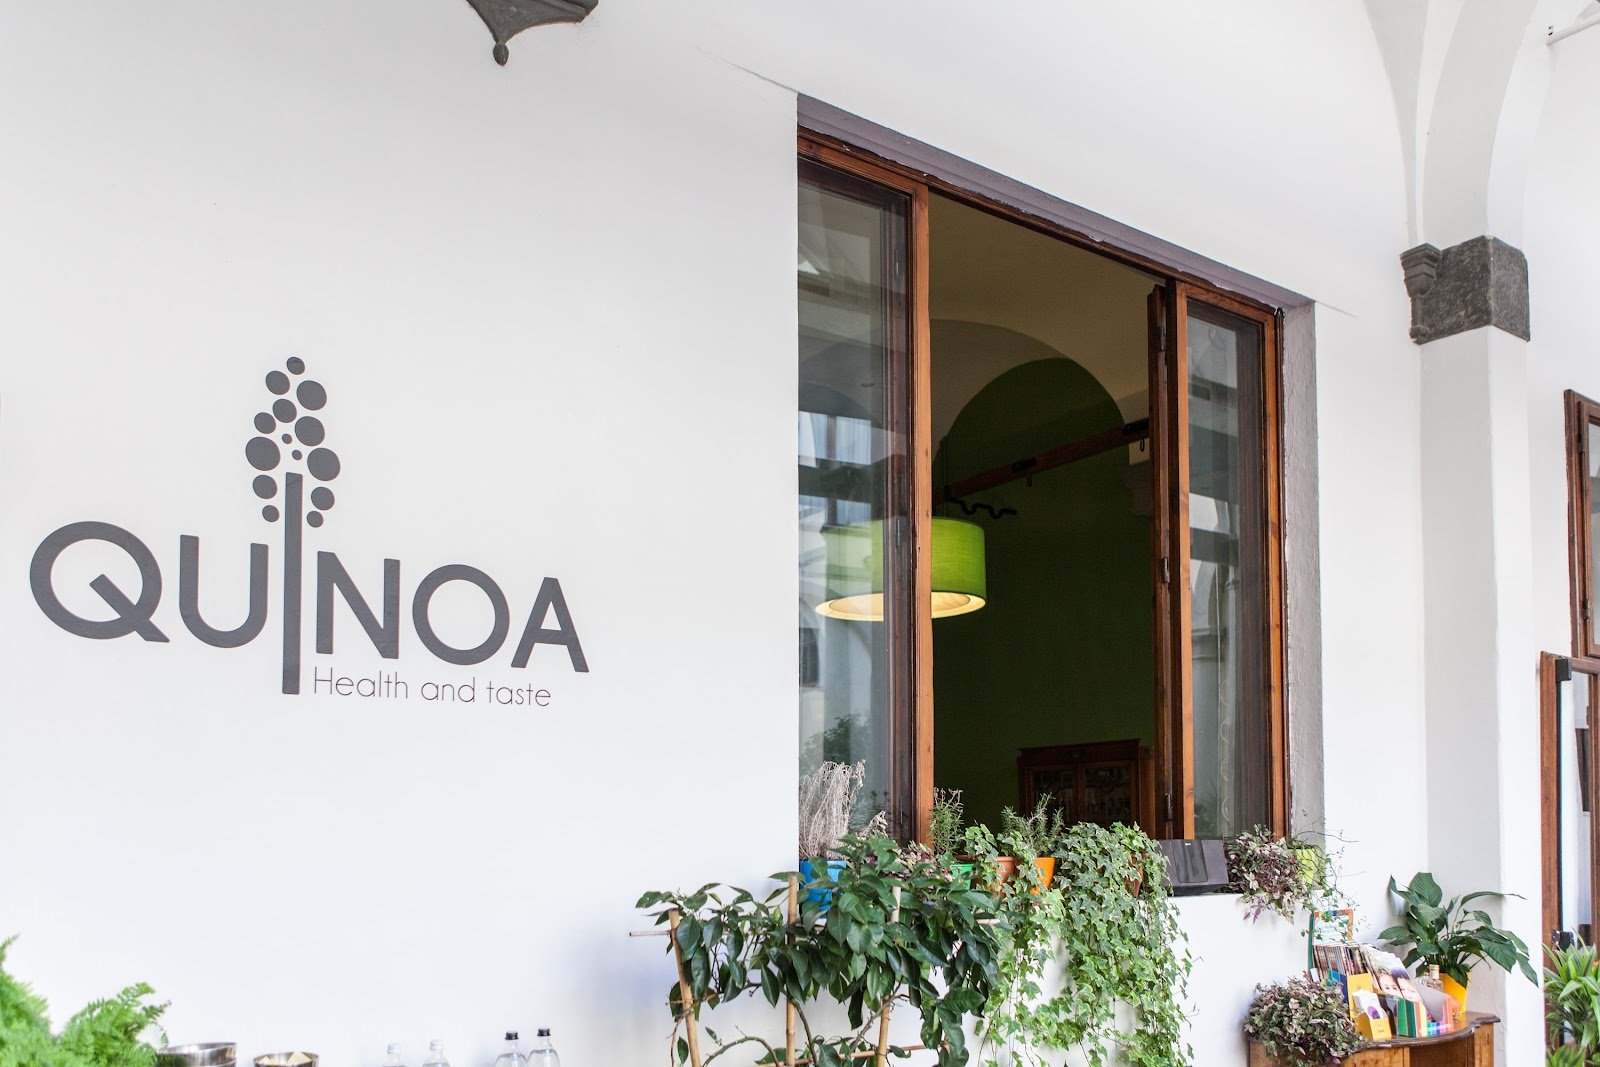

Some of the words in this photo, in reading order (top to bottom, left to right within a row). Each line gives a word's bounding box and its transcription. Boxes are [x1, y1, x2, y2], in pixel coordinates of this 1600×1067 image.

[30, 472, 590, 696] QUINOA
[314, 666, 409, 699] Health
[421, 676, 476, 703] and
[486, 680, 552, 707] taste
